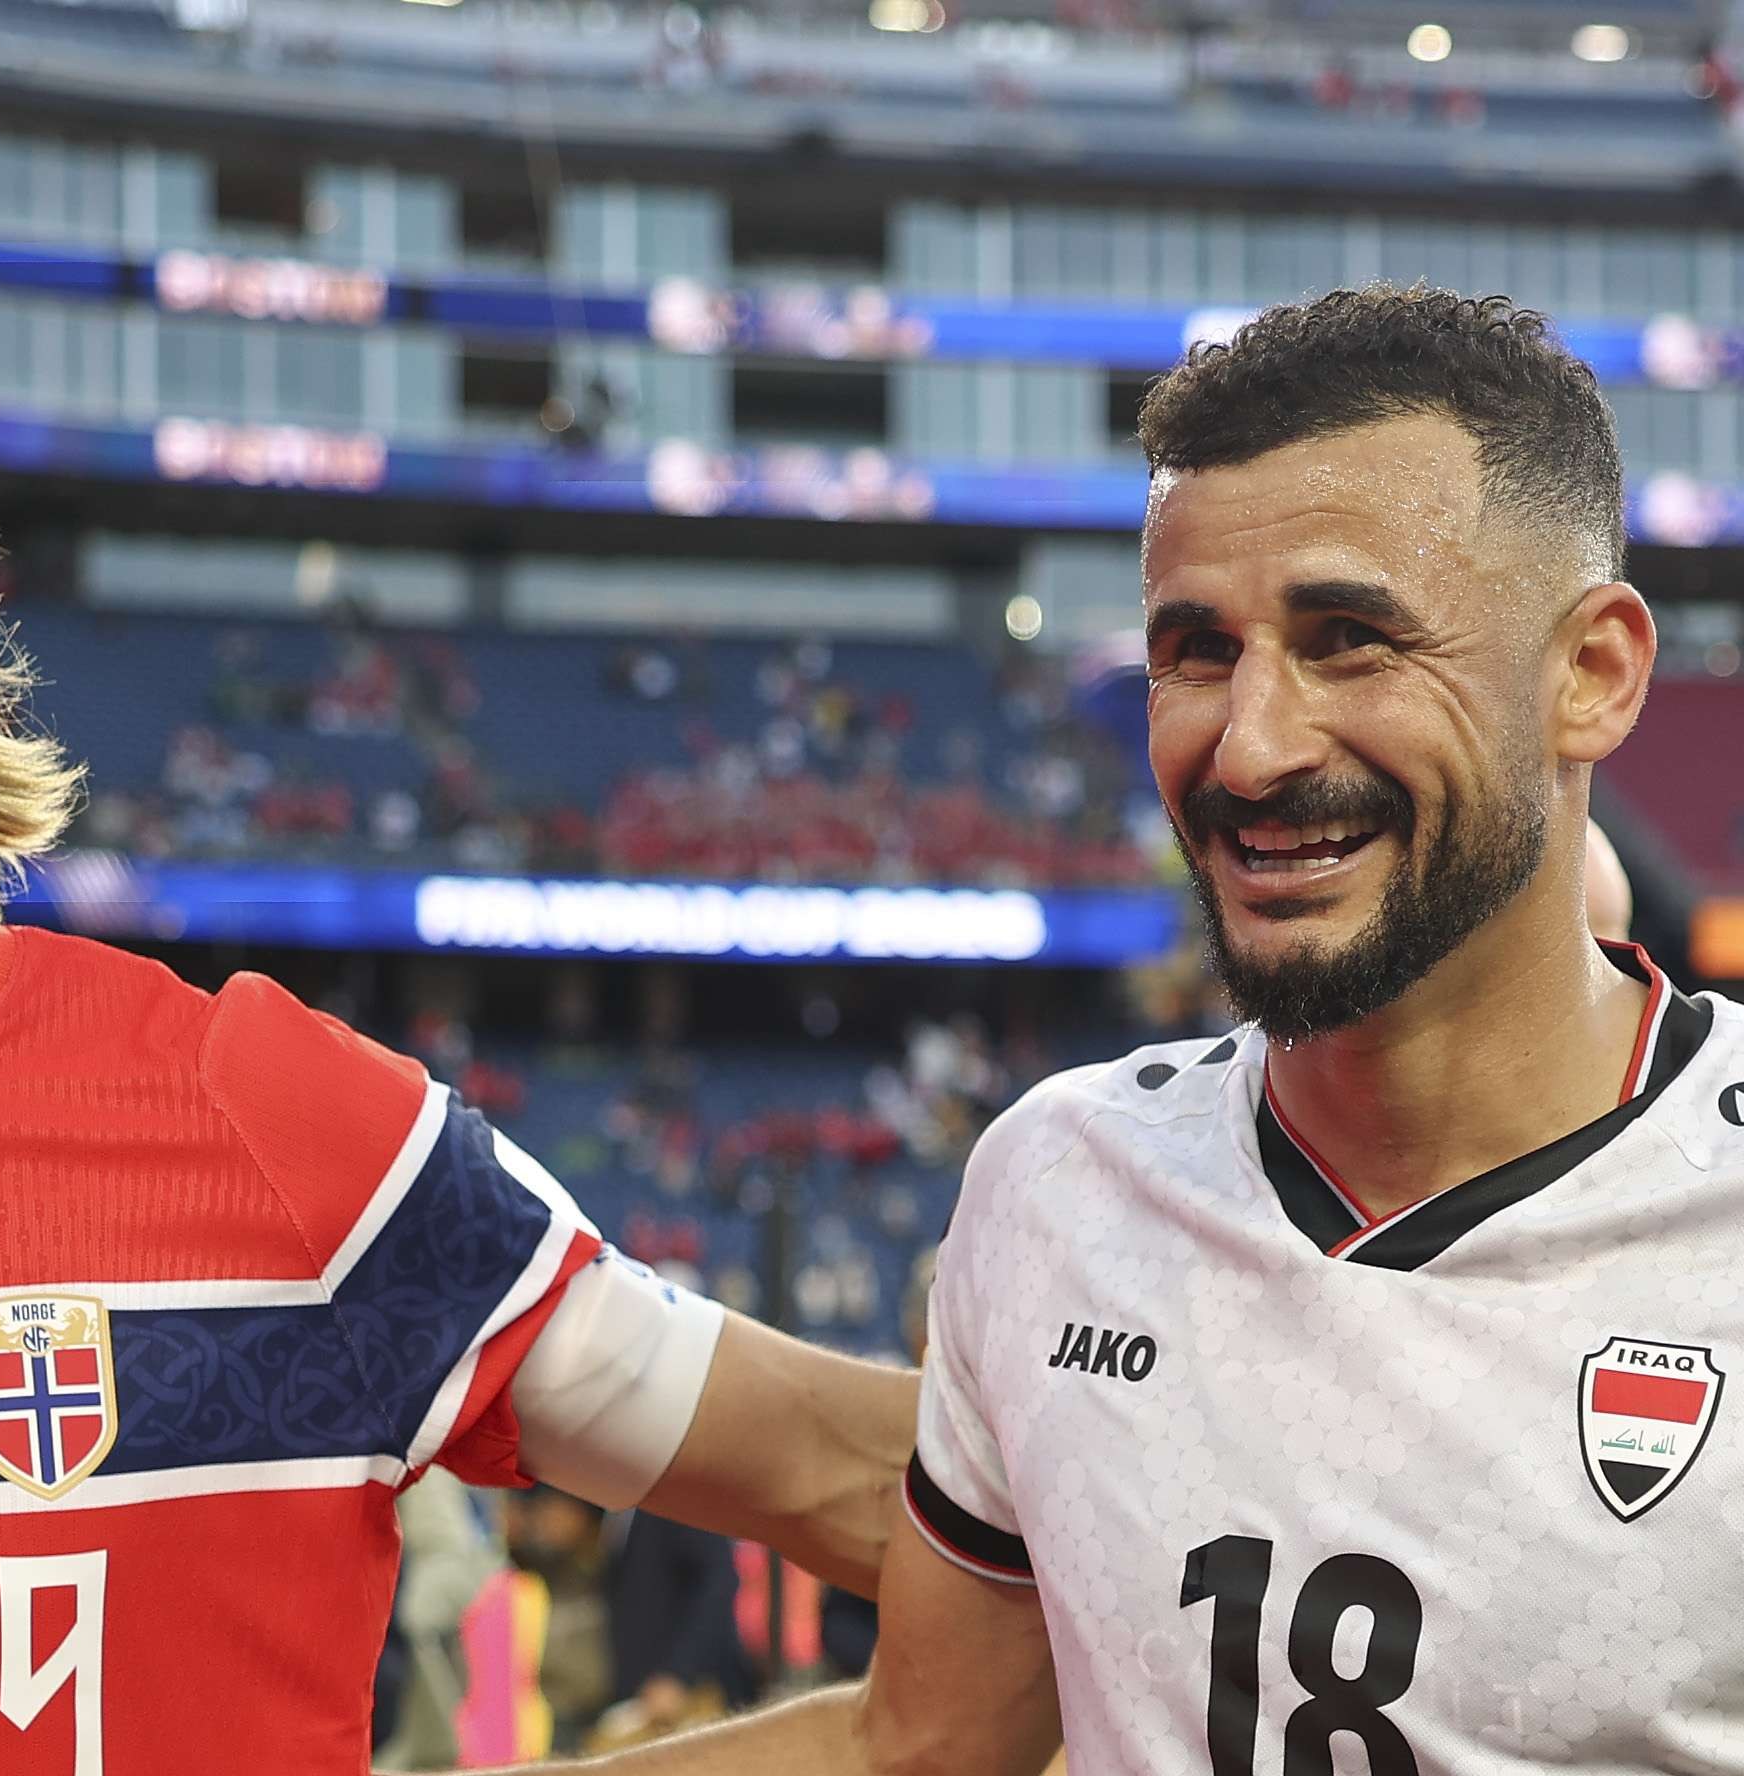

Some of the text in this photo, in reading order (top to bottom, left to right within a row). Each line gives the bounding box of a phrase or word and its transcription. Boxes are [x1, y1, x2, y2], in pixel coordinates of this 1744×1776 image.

[11, 1303, 56, 1322] NORGE
[1048, 1322, 1157, 1382] JAKO
[1617, 1348, 1695, 1373] IRAQ
